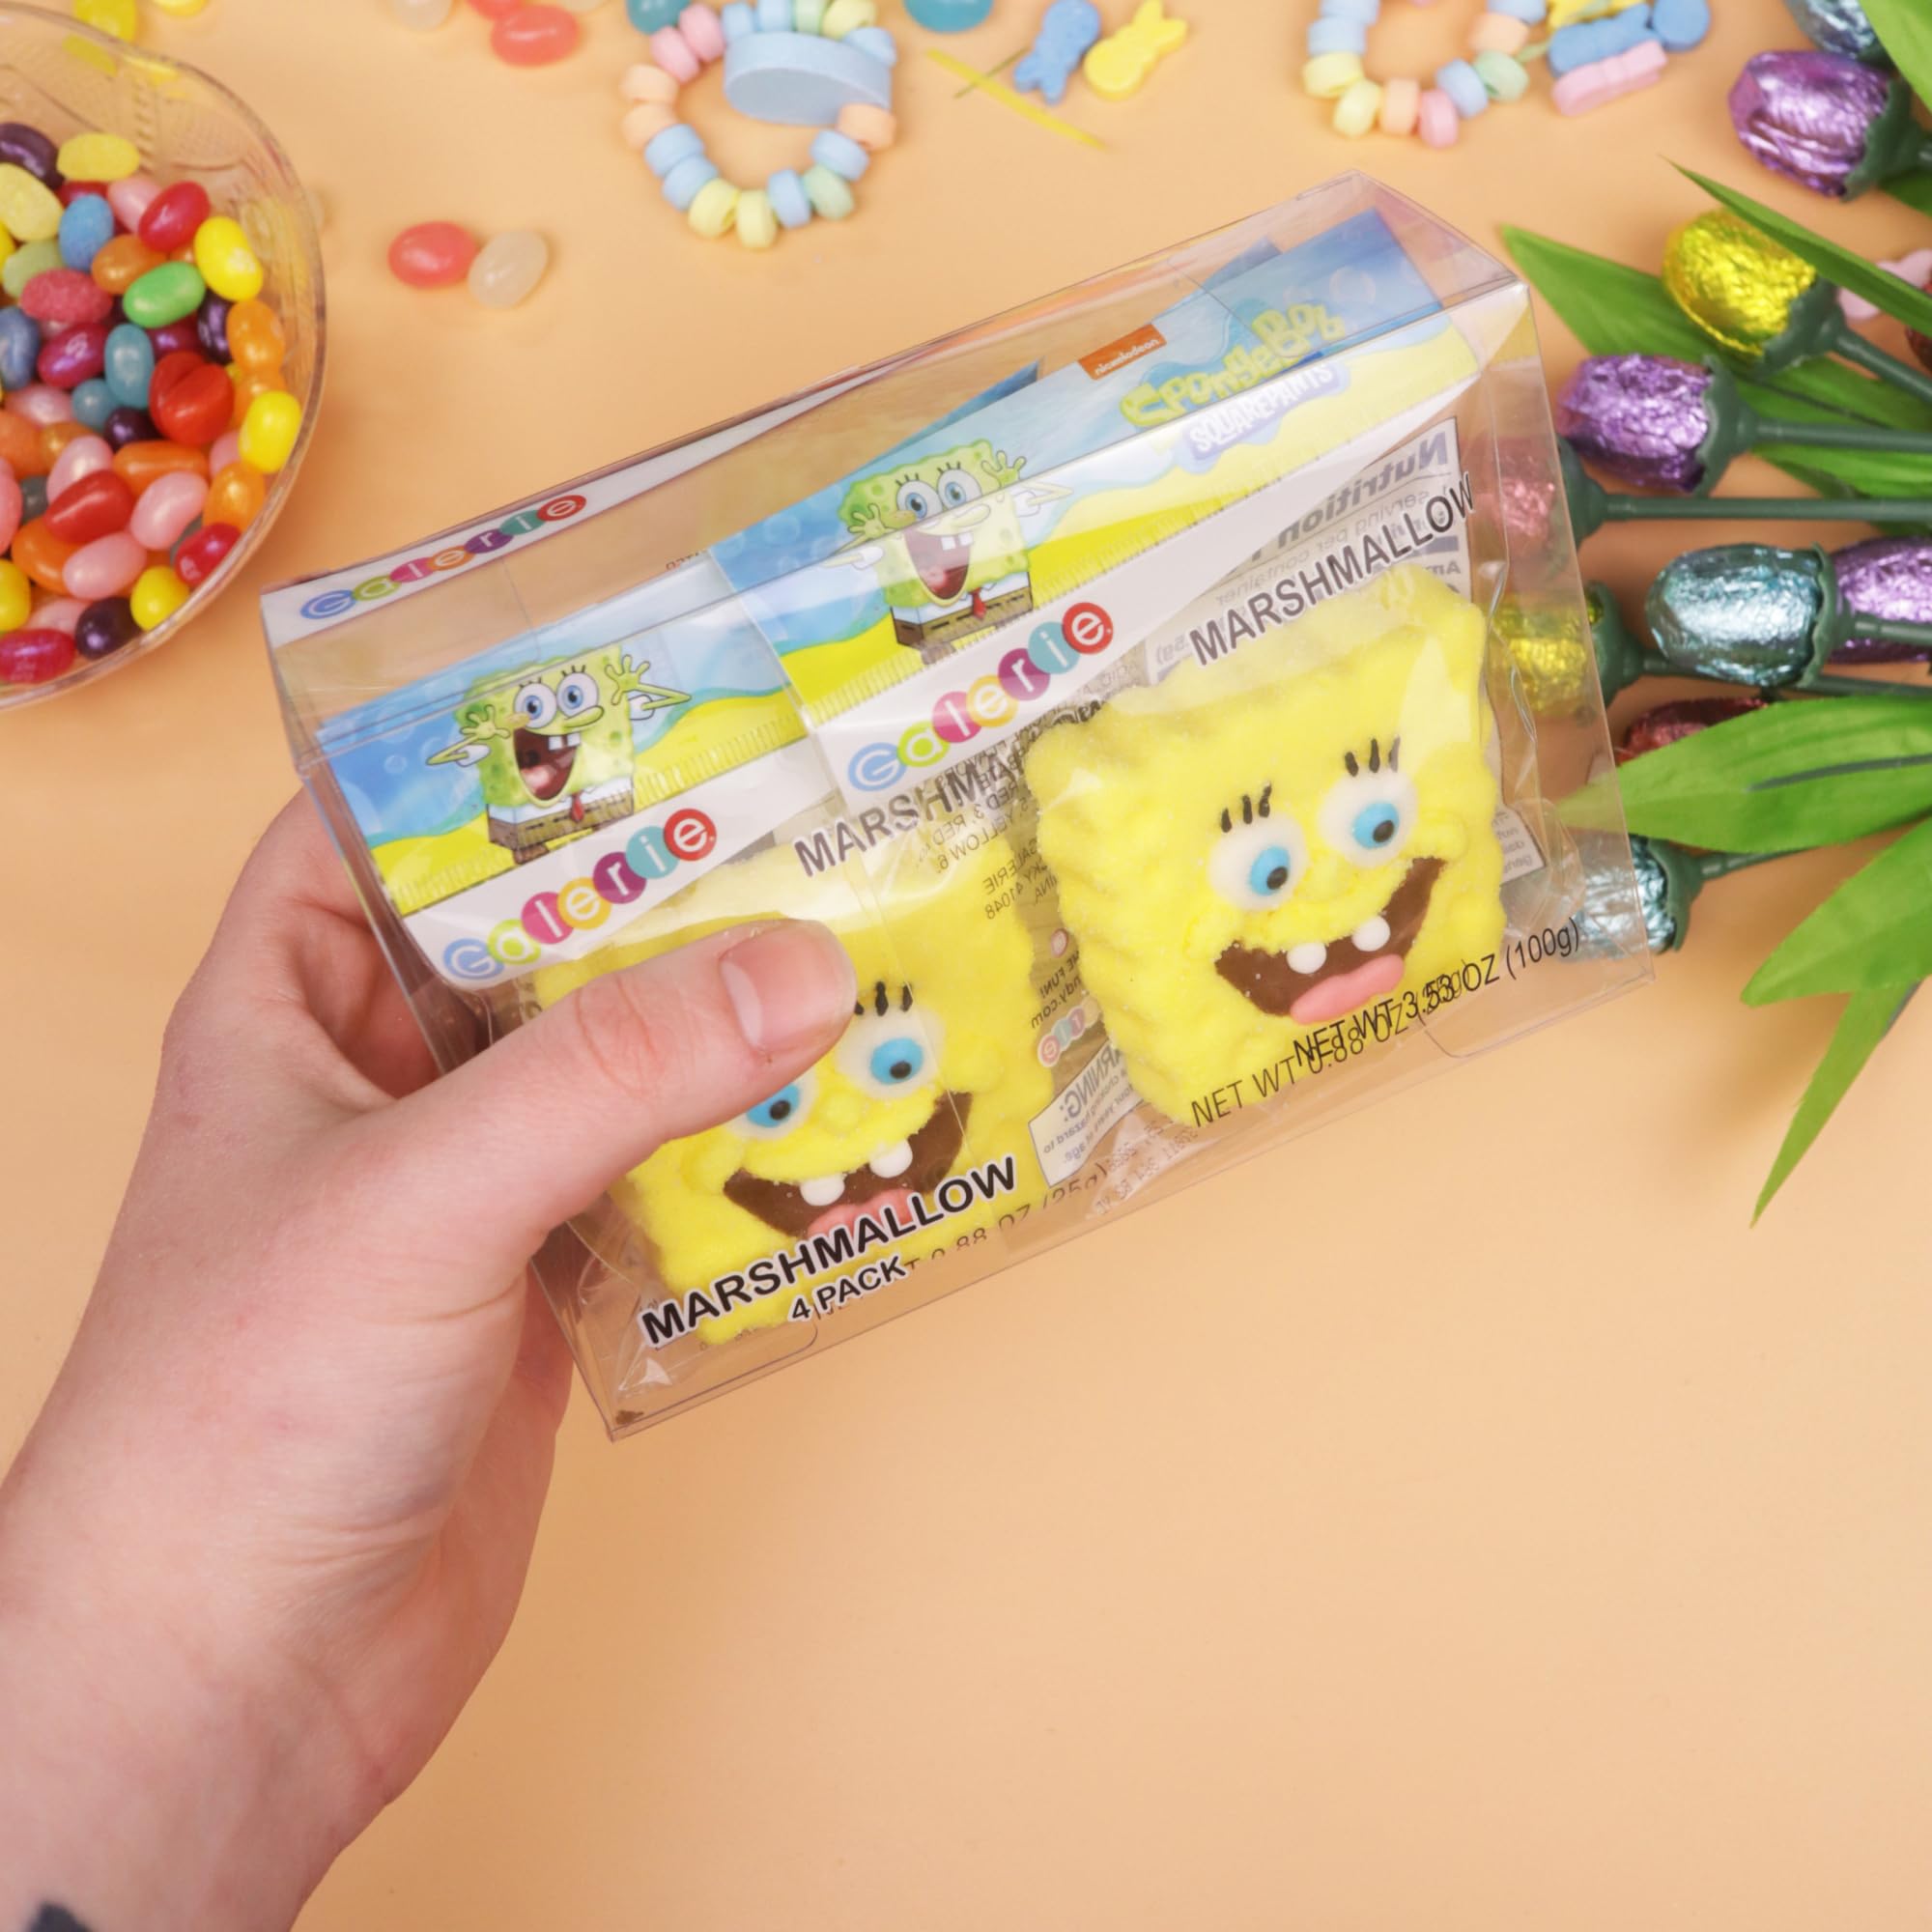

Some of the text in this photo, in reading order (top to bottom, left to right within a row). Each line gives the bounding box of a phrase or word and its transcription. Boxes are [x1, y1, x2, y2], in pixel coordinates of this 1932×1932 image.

[1189, 362, 1334, 453] SQUAREPANTS
[300, 495, 586, 619] Galerie
[1189, 472, 1474, 667] MARSHMALLOW
[848, 602, 1114, 792] Galerie
[443, 809, 717, 980] Galerie
[1463, 952, 1500, 992] OZ
[1505, 918, 1580, 980] (100g)
[1190, 1079, 1244, 1128] NET
[1252, 1055, 1295, 1099] WT
[641, 1155, 1016, 1346] MARSHMALLOW
[791, 1297, 811, 1321] 4
[816, 1256, 906, 1311] PACK
